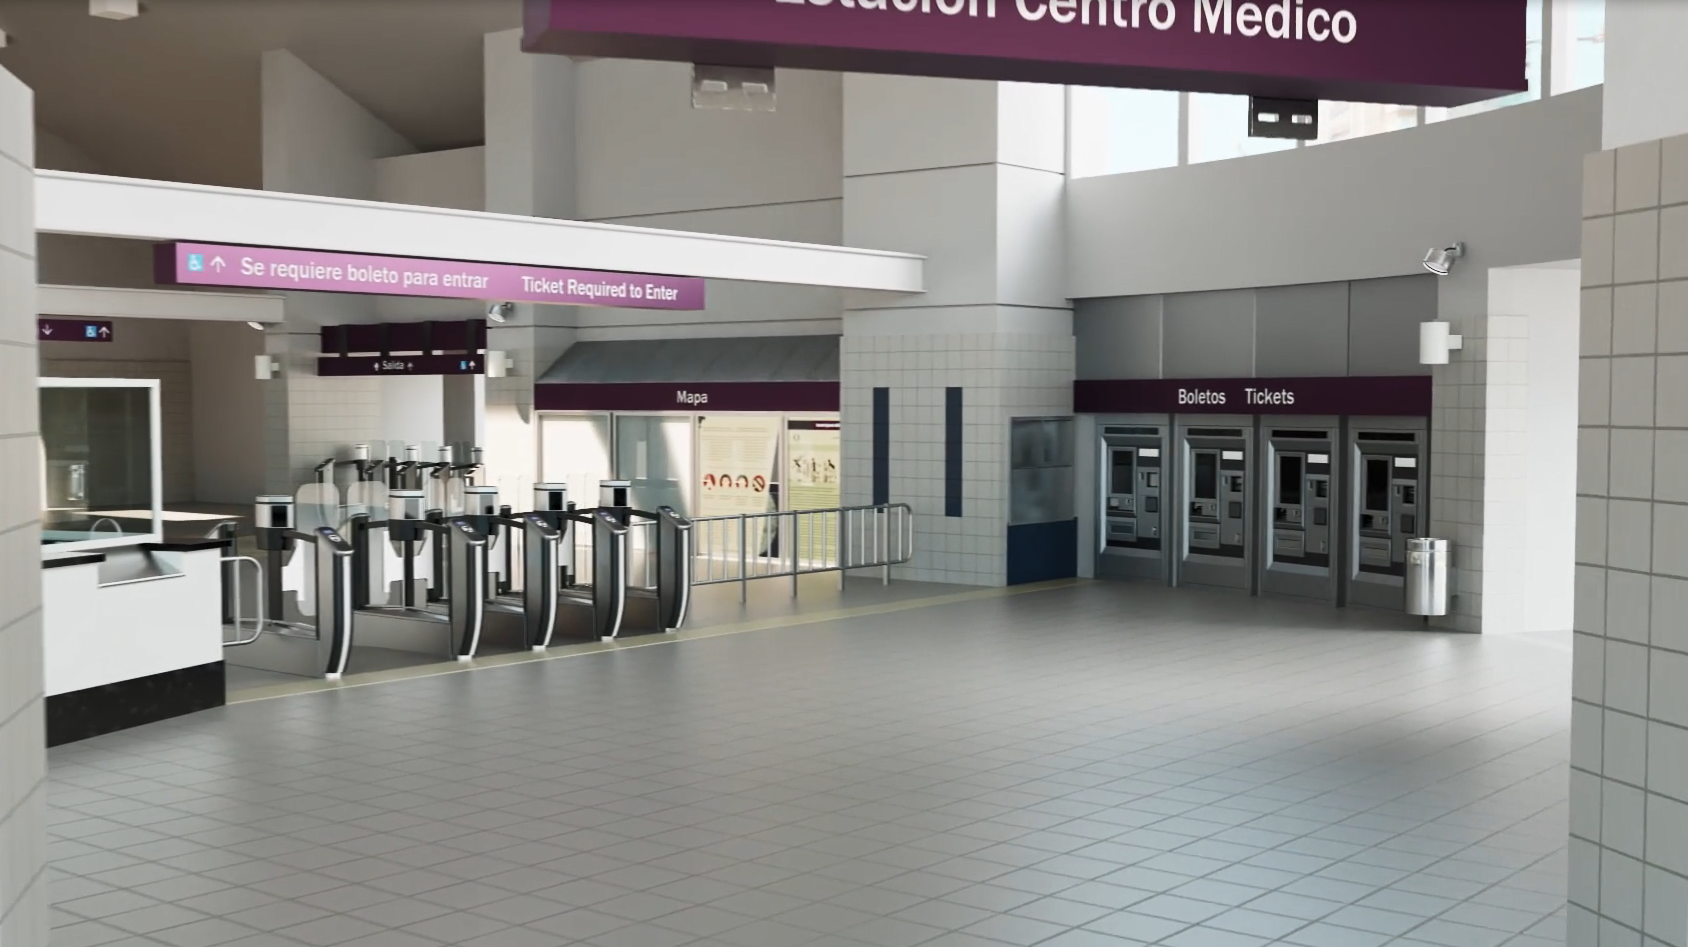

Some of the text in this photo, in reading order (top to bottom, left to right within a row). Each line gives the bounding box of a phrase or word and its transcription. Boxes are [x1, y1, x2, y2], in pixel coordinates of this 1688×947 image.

[1016, 0, 1176, 31] Centro
[1193, 0, 1357, 44] Medico
[241, 257, 489, 289] Se requiere boleto para entrar
[521, 276, 679, 301] Ticket Required to Enter
[676, 390, 708, 407] Mapa
[1178, 388, 1295, 405] Boletos Tickets
